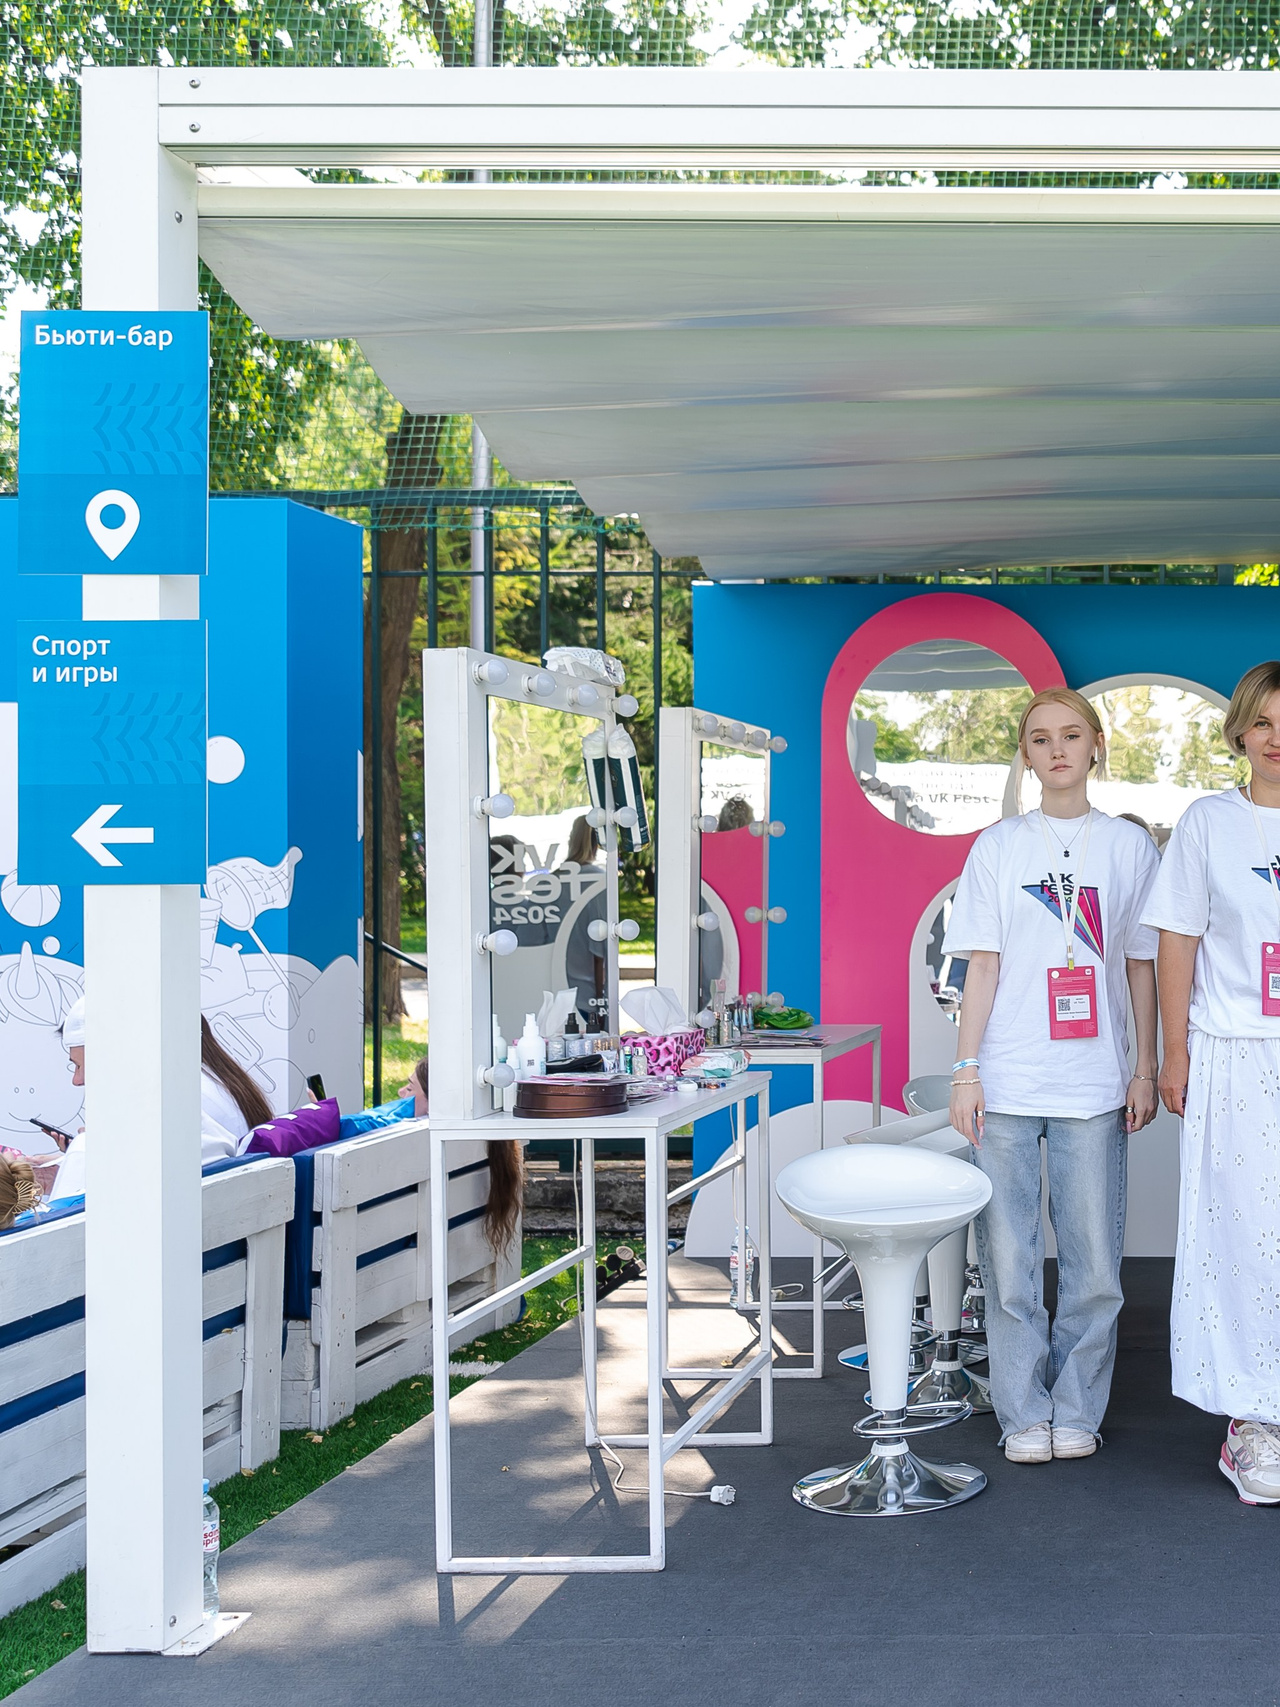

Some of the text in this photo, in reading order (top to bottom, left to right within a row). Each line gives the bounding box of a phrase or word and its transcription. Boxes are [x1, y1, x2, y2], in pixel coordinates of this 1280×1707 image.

[34, 324, 173, 350] Бьюти-бар
[32, 634, 111, 660] Спорт
[32, 666, 118, 687] и игры
